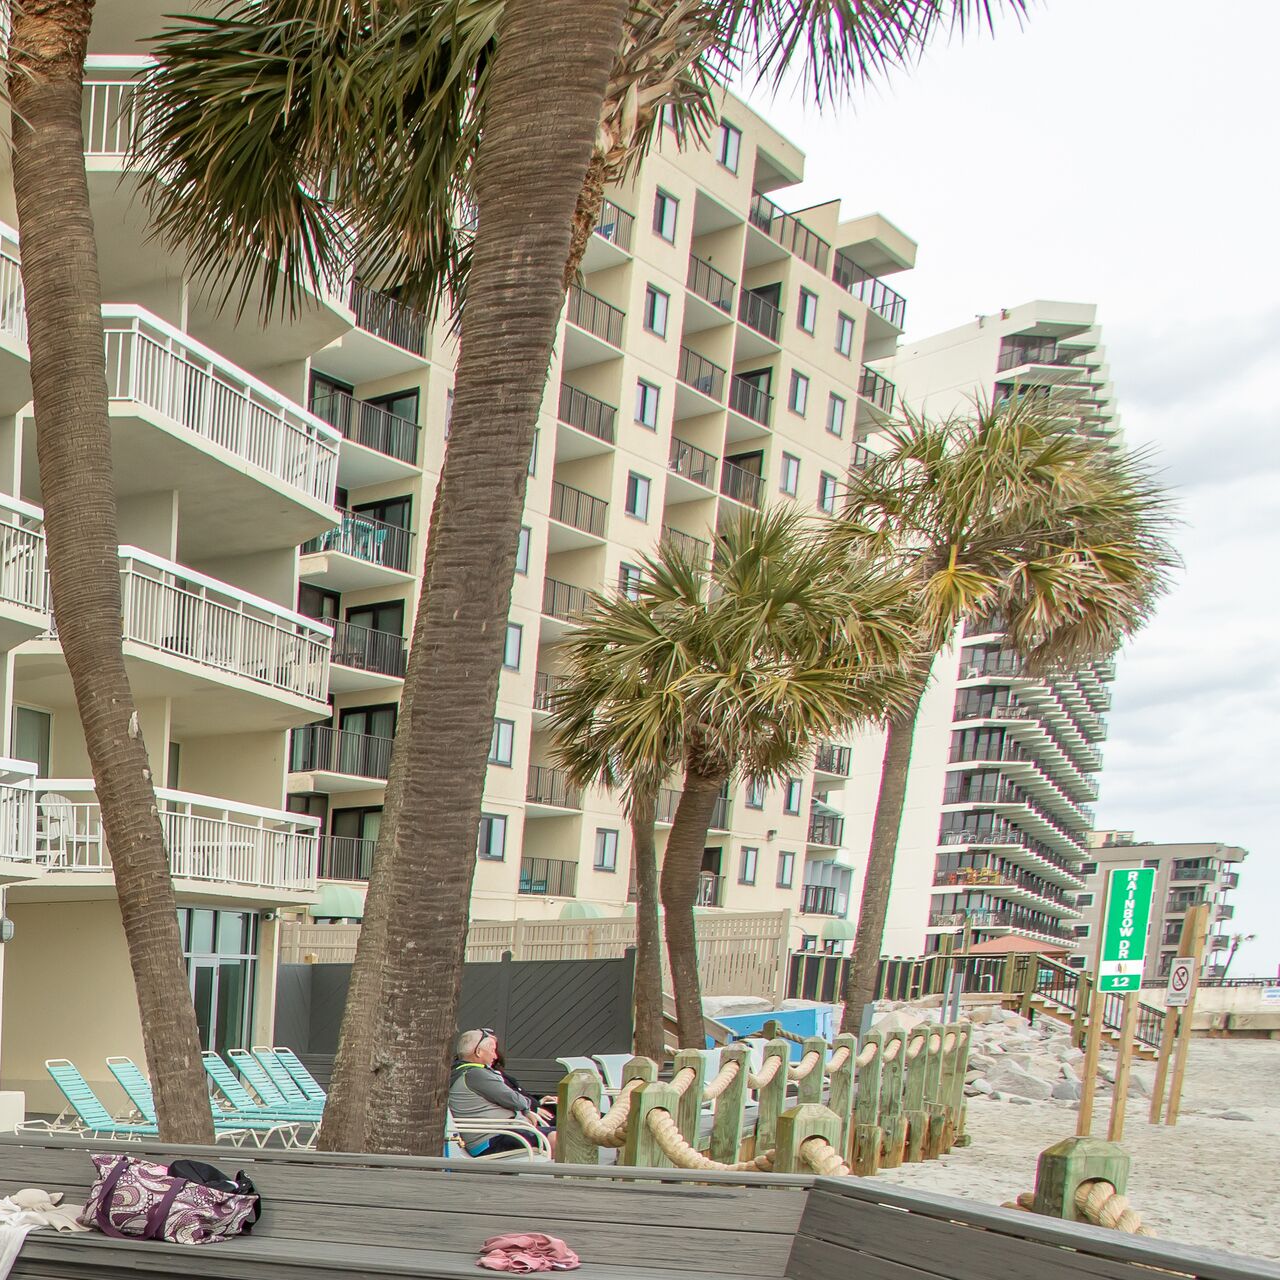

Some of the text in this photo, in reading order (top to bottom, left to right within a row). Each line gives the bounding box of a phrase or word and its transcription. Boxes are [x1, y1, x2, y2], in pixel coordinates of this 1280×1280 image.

[1118, 871, 1139, 960] RAINBOW DR
[1111, 977, 1130, 988] 12
